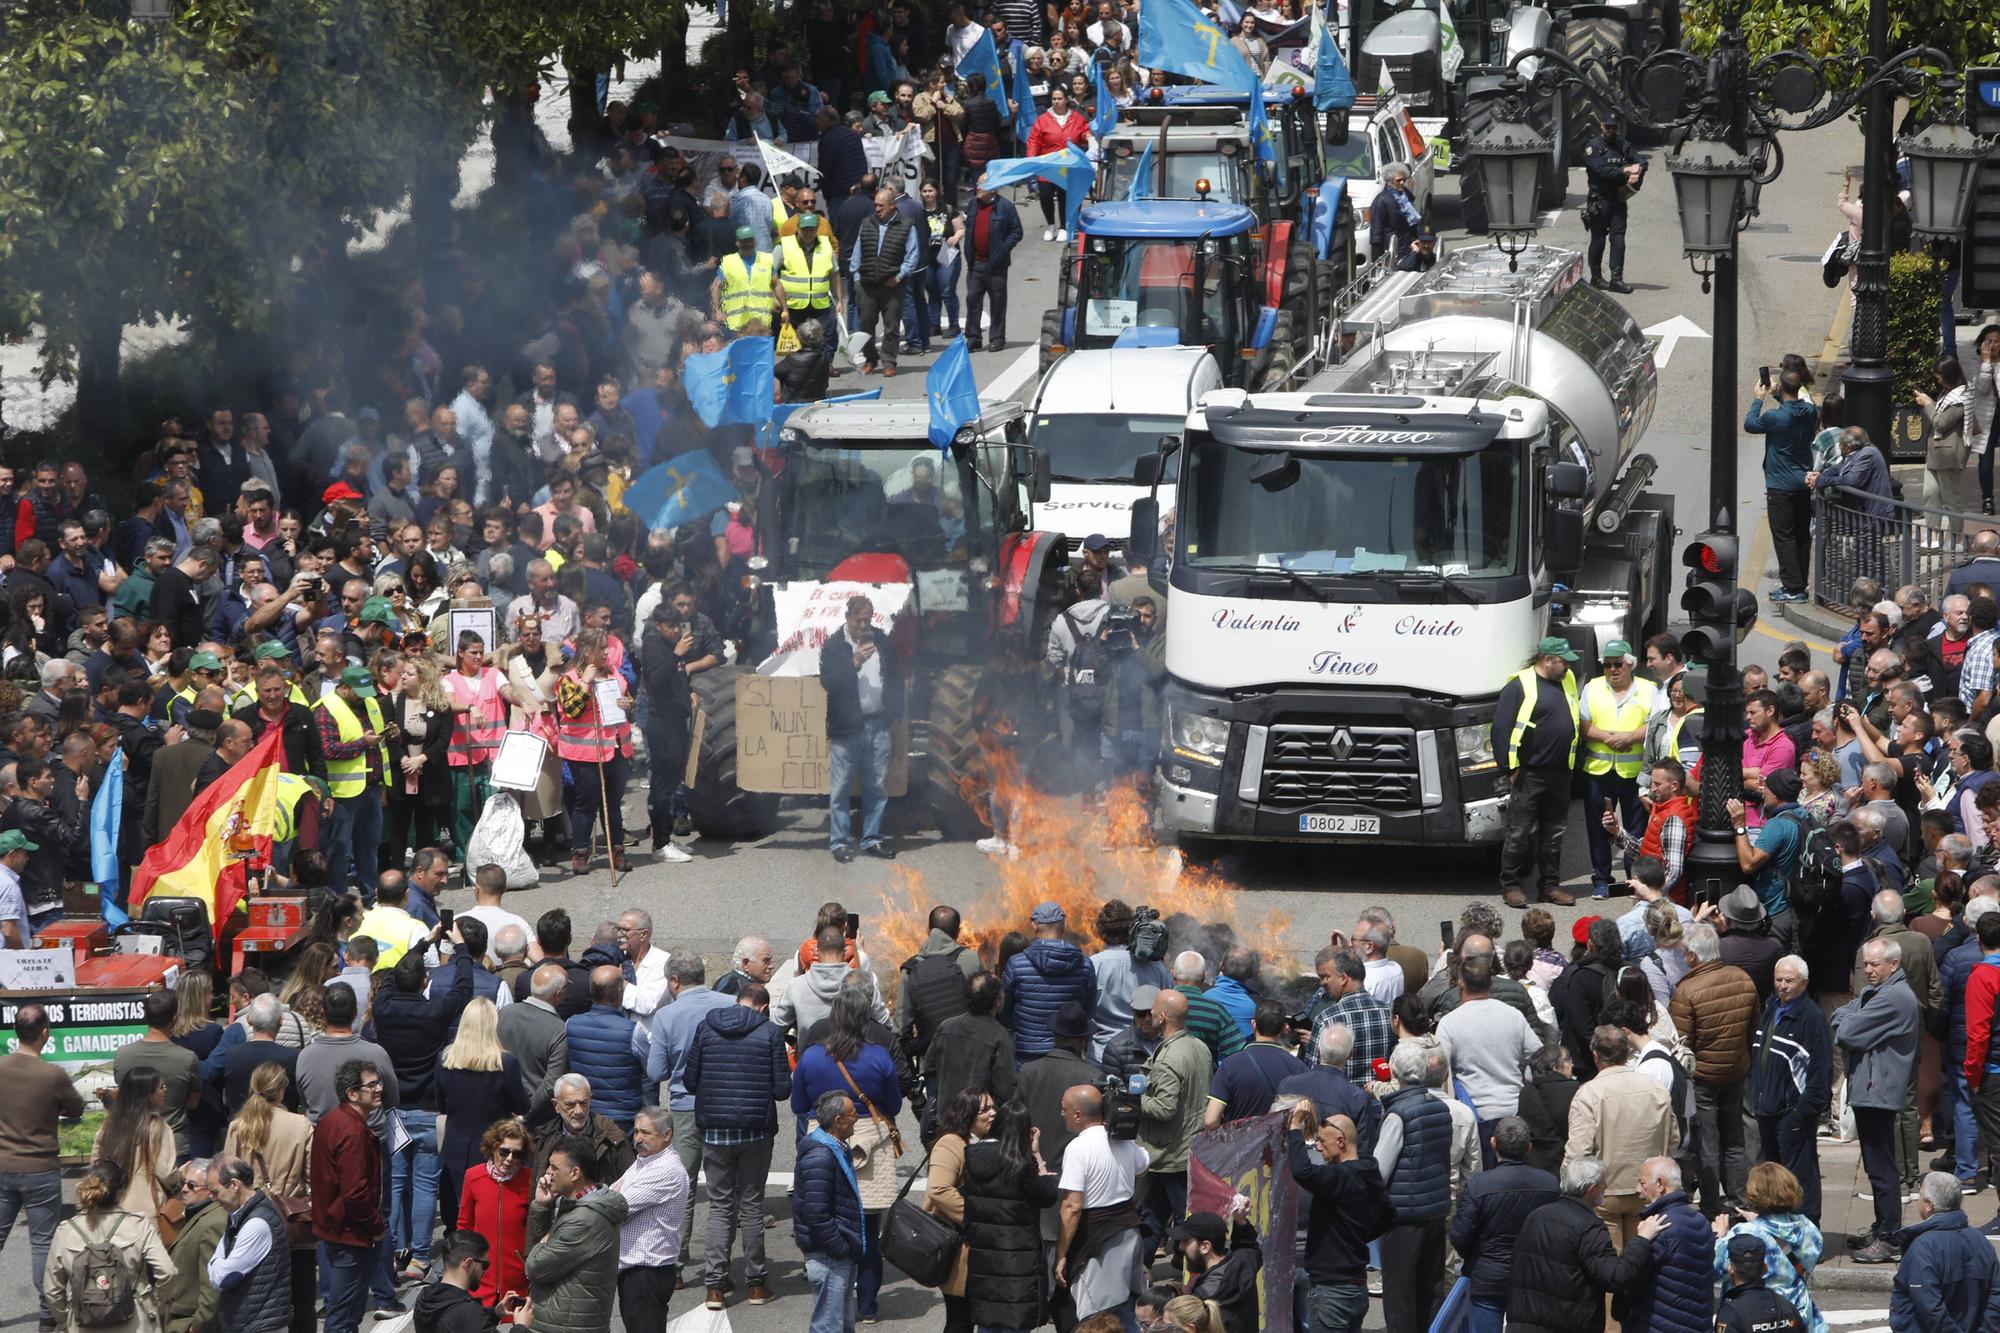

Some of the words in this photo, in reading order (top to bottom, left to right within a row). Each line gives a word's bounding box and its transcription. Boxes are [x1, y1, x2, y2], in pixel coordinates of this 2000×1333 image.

[1299, 425, 1434, 444] Tineo
[1394, 615, 1464, 637] Olvido
[1308, 650, 1378, 675] Tineo
[744, 736, 768, 757] LA
[1309, 817, 1345, 831] 0802
[1350, 819, 1377, 832] JBZ
[69, 1001, 145, 1022] TERRORISTAS
